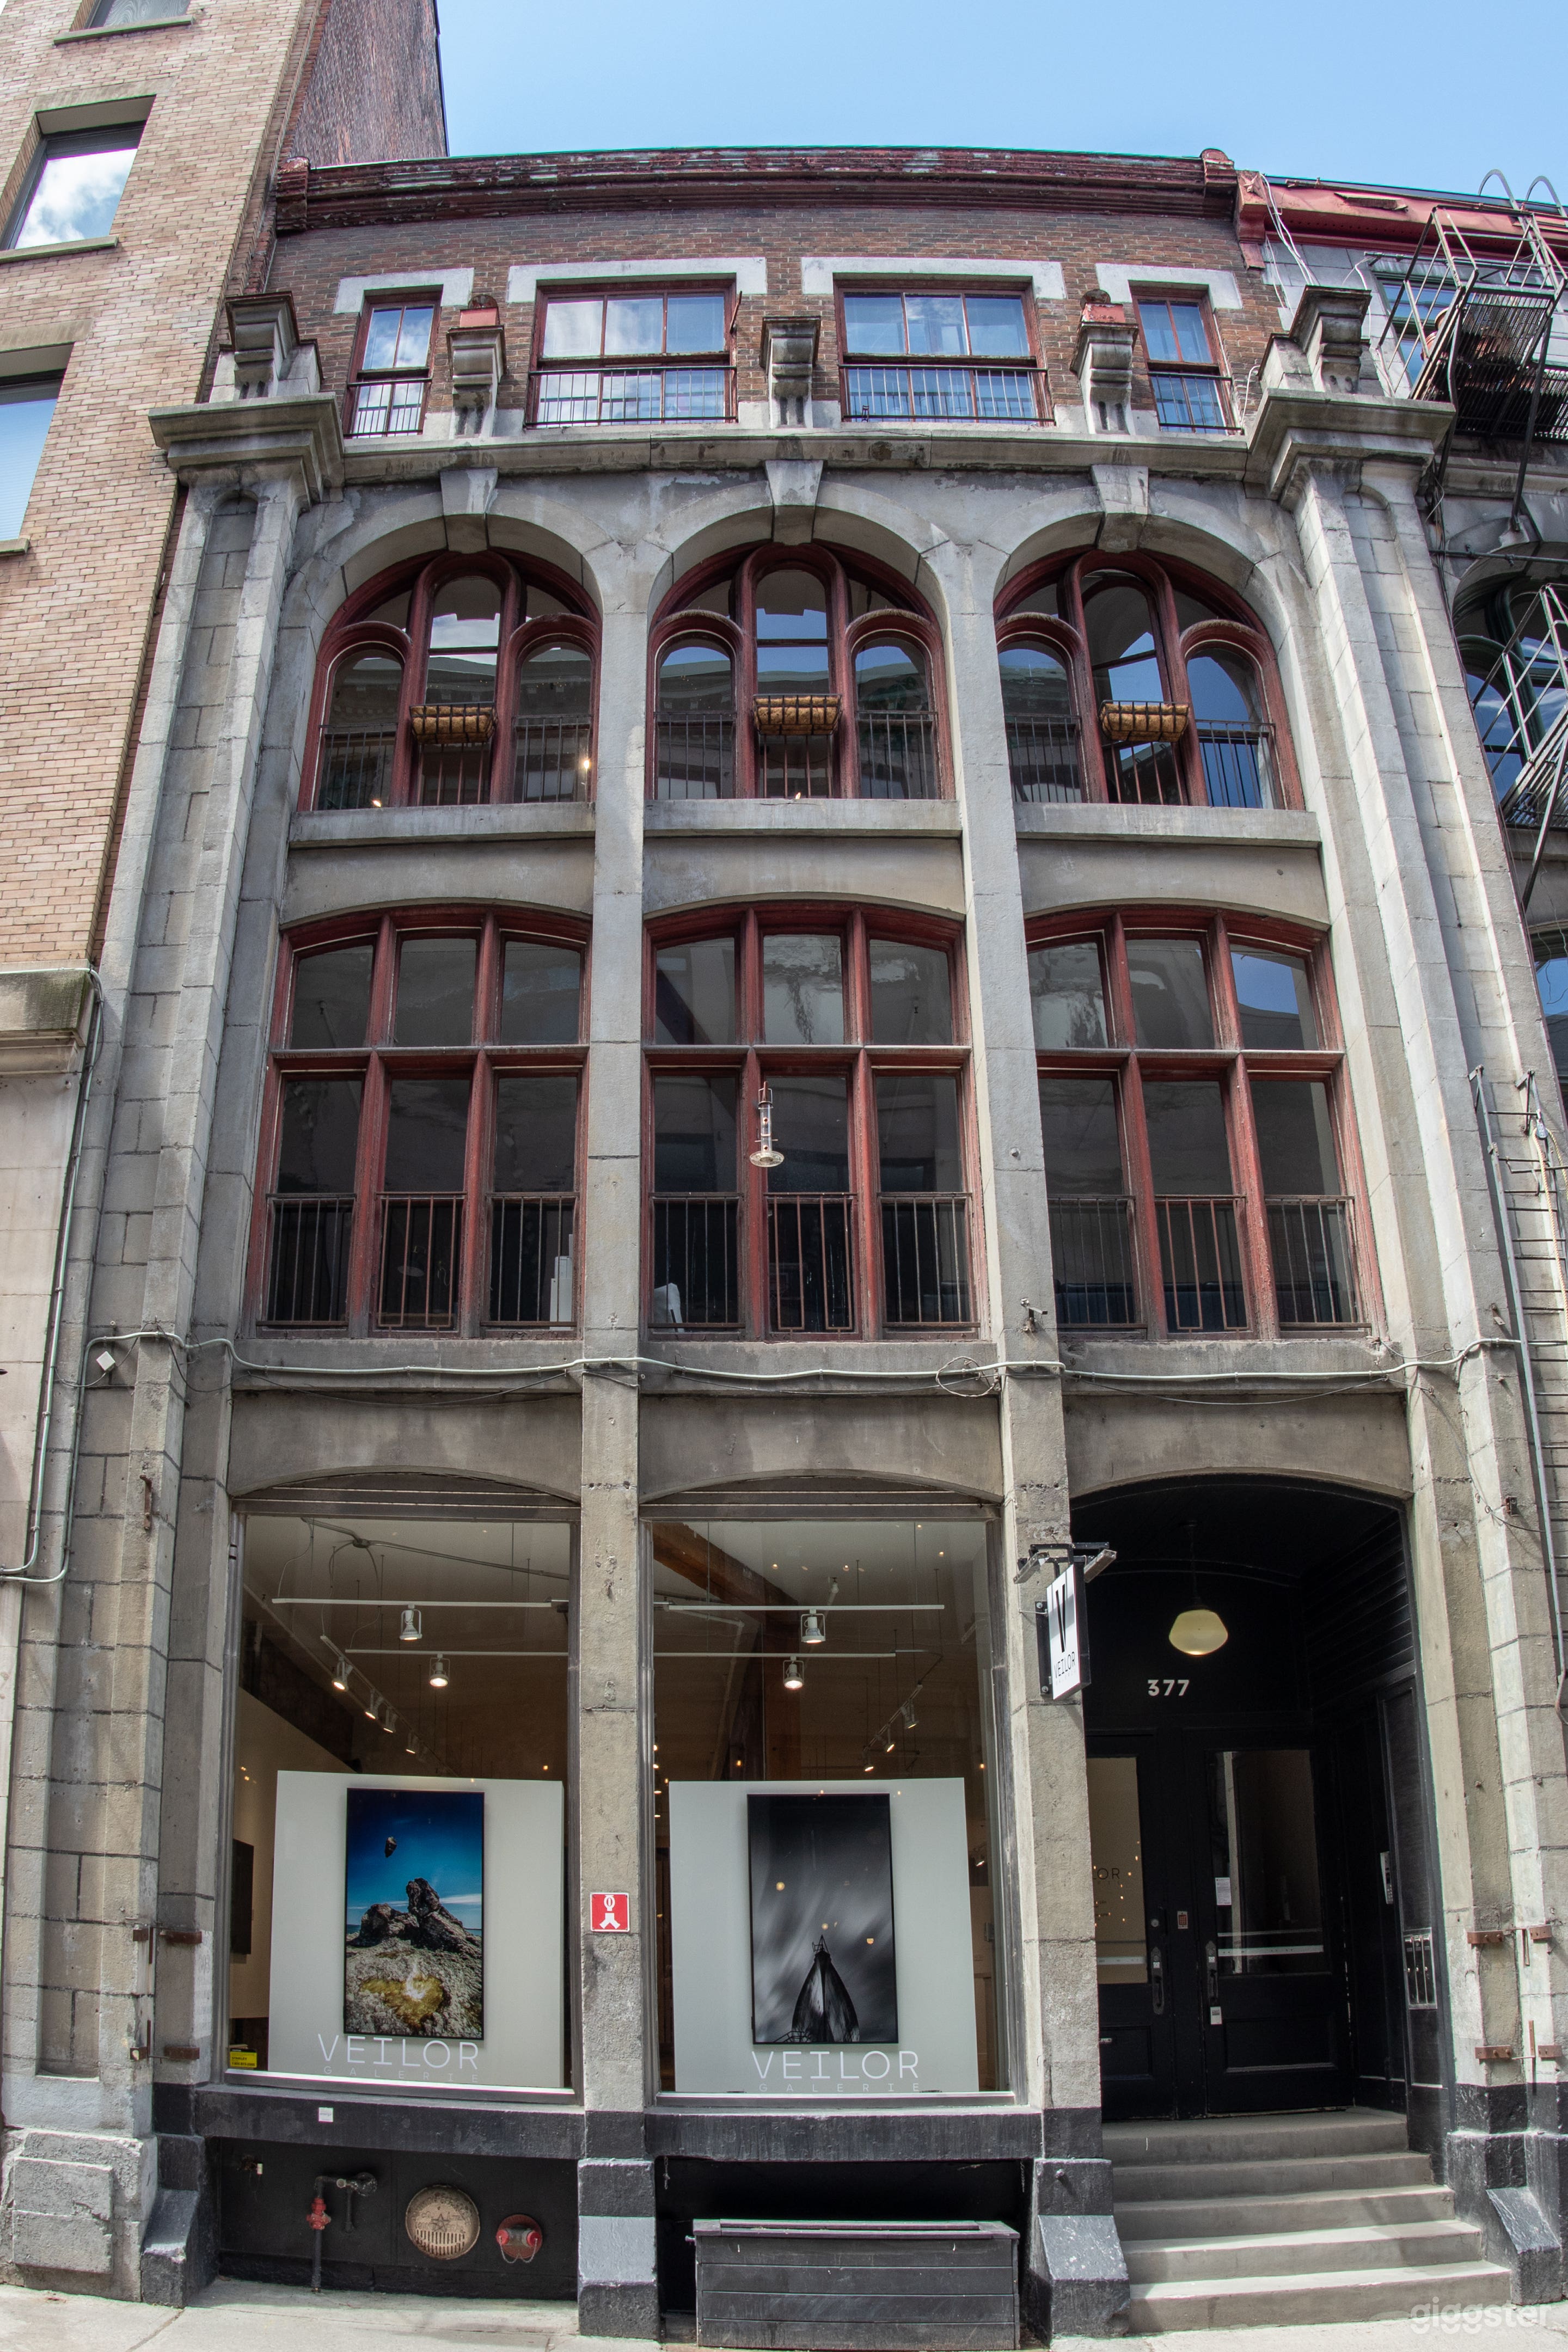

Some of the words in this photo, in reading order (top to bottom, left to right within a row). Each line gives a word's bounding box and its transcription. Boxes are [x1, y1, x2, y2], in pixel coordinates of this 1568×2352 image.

[1055, 1584, 1067, 1653] V
[1054, 1651, 1076, 1679] VEILOR
[1147, 1679, 1190, 1696] 377
[317, 2033, 479, 2069] VEILOR
[751, 2050, 918, 2079] VEILOR
[323, 2065, 479, 2082] GALERIE
[758, 2082, 920, 2092] GALERIE
